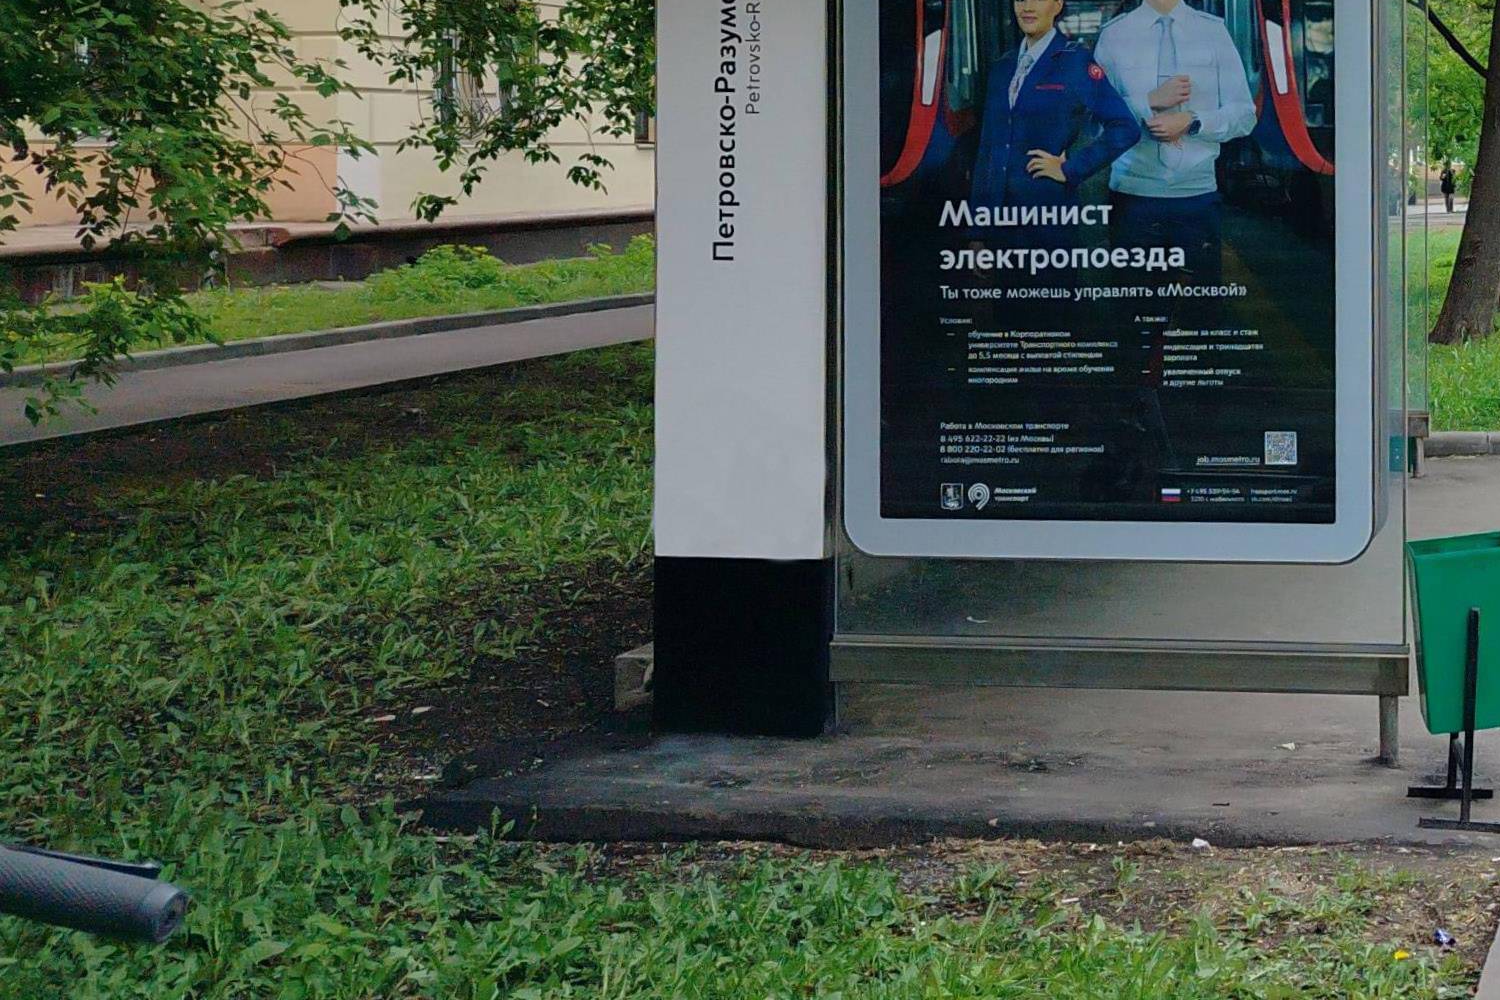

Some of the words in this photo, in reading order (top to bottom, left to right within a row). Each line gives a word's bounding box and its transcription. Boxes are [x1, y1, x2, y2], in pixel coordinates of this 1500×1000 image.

[939, 200, 1113, 227] Машинист
[940, 246, 1185, 275] электропоезда
[940, 286, 958, 299] Ты
[963, 287, 1002, 299] тоже
[1006, 286, 1071, 299] можешь
[1074, 286, 1153, 301] управлять
[1157, 283, 1247, 297] «Москвой»
[940, 421, 967, 430] Работа
[947, 435, 963, 443] 495
